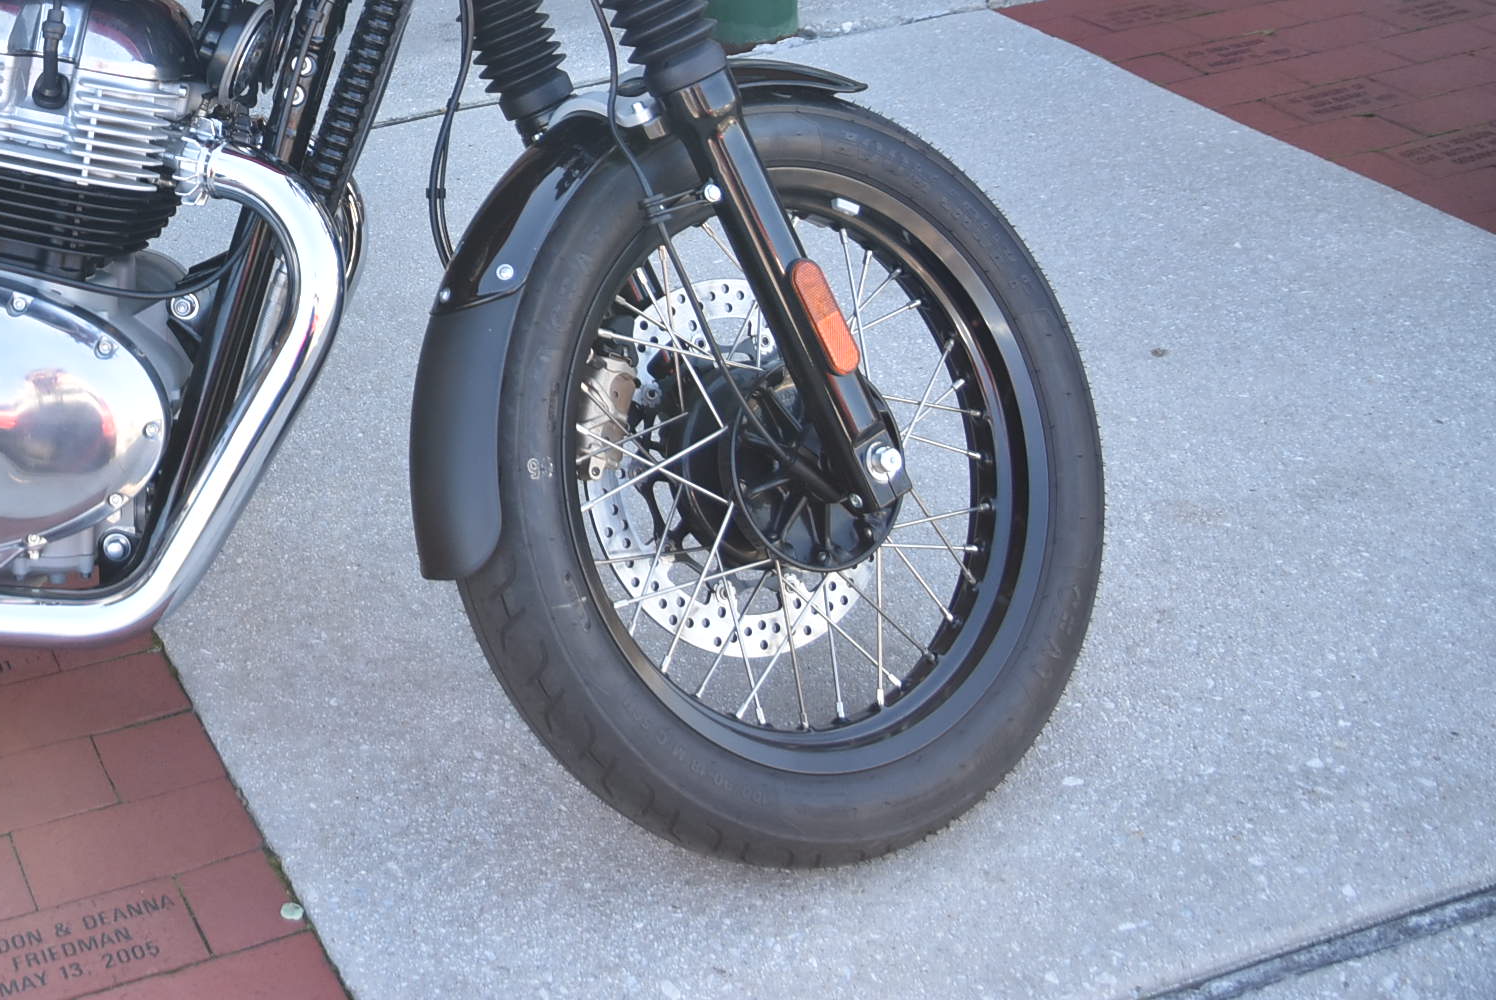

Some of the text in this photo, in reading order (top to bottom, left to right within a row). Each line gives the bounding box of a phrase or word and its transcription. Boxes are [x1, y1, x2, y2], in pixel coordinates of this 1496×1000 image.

[54, 922, 73, 937] &
[82, 893, 175, 931] DEANNA
[12, 928, 134, 972] FRIEDMAN
[102, 940, 161, 970] 2005
